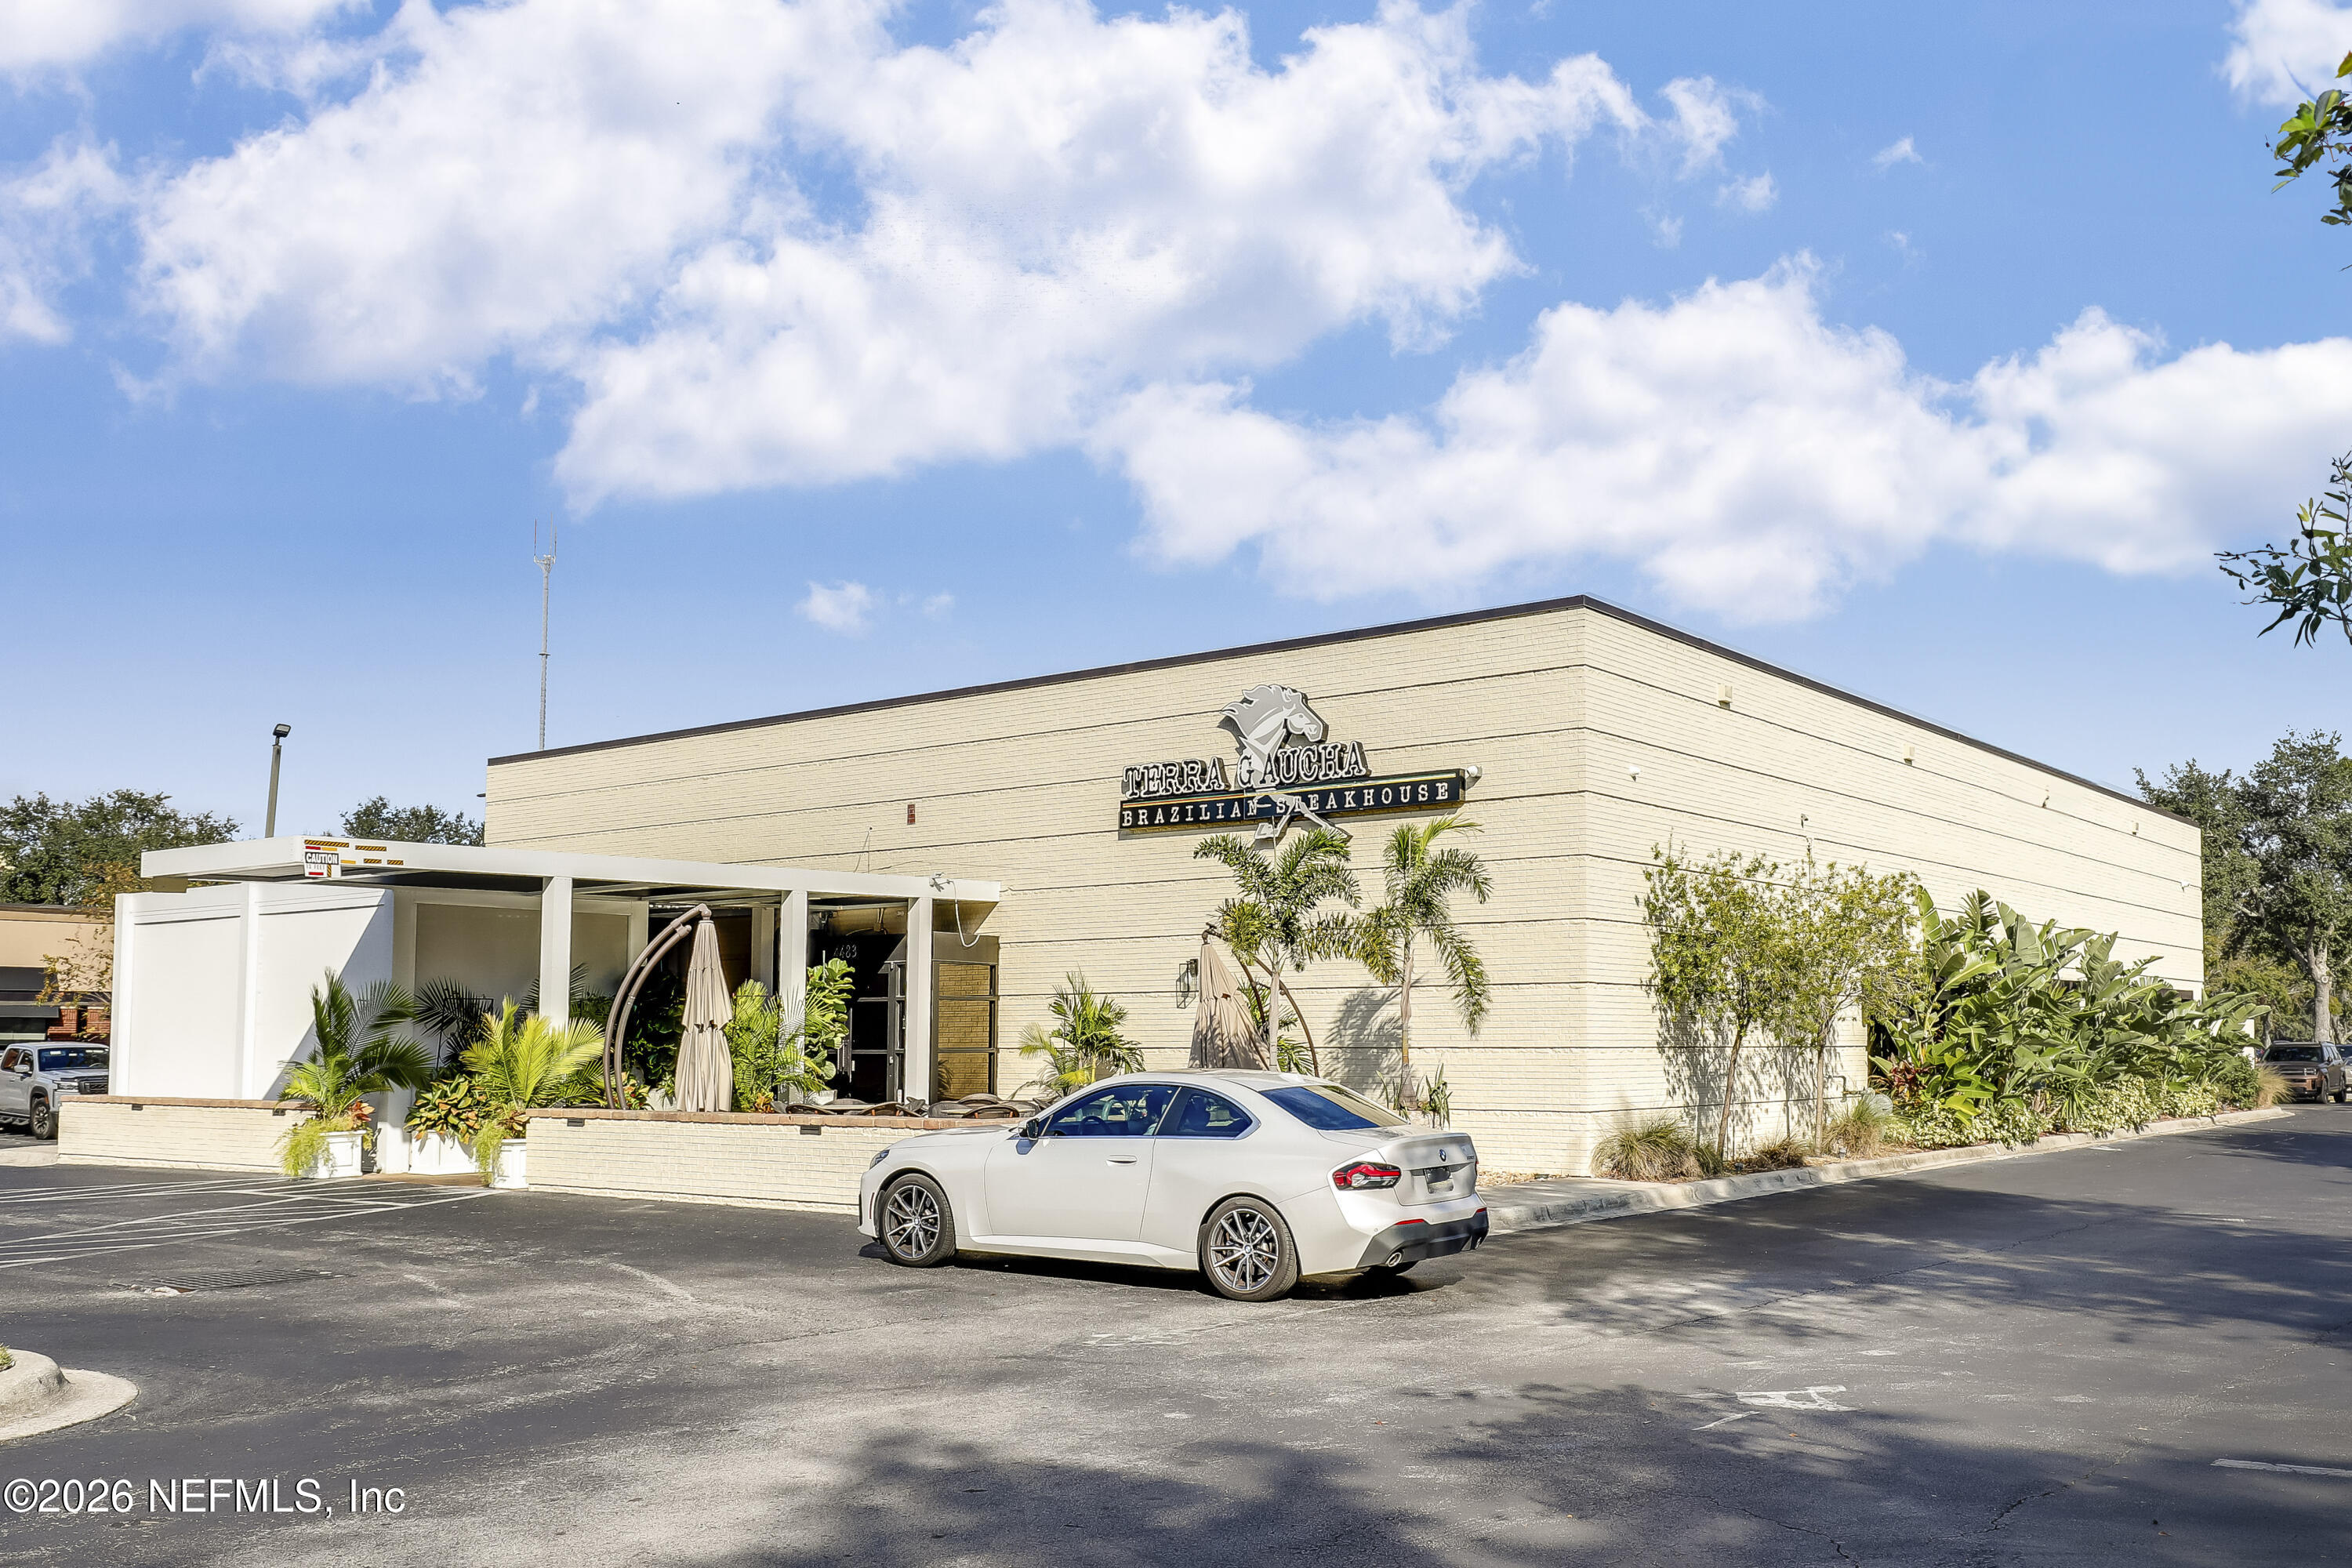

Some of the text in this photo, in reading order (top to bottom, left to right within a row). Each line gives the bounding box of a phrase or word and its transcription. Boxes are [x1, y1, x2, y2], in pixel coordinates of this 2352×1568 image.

[1123, 746, 1367, 798] TERRA GAUCHA
[1122, 782, 1448, 826] BRAZILIAN STEAKHOUSE
[306, 852, 338, 863] CAUTION
